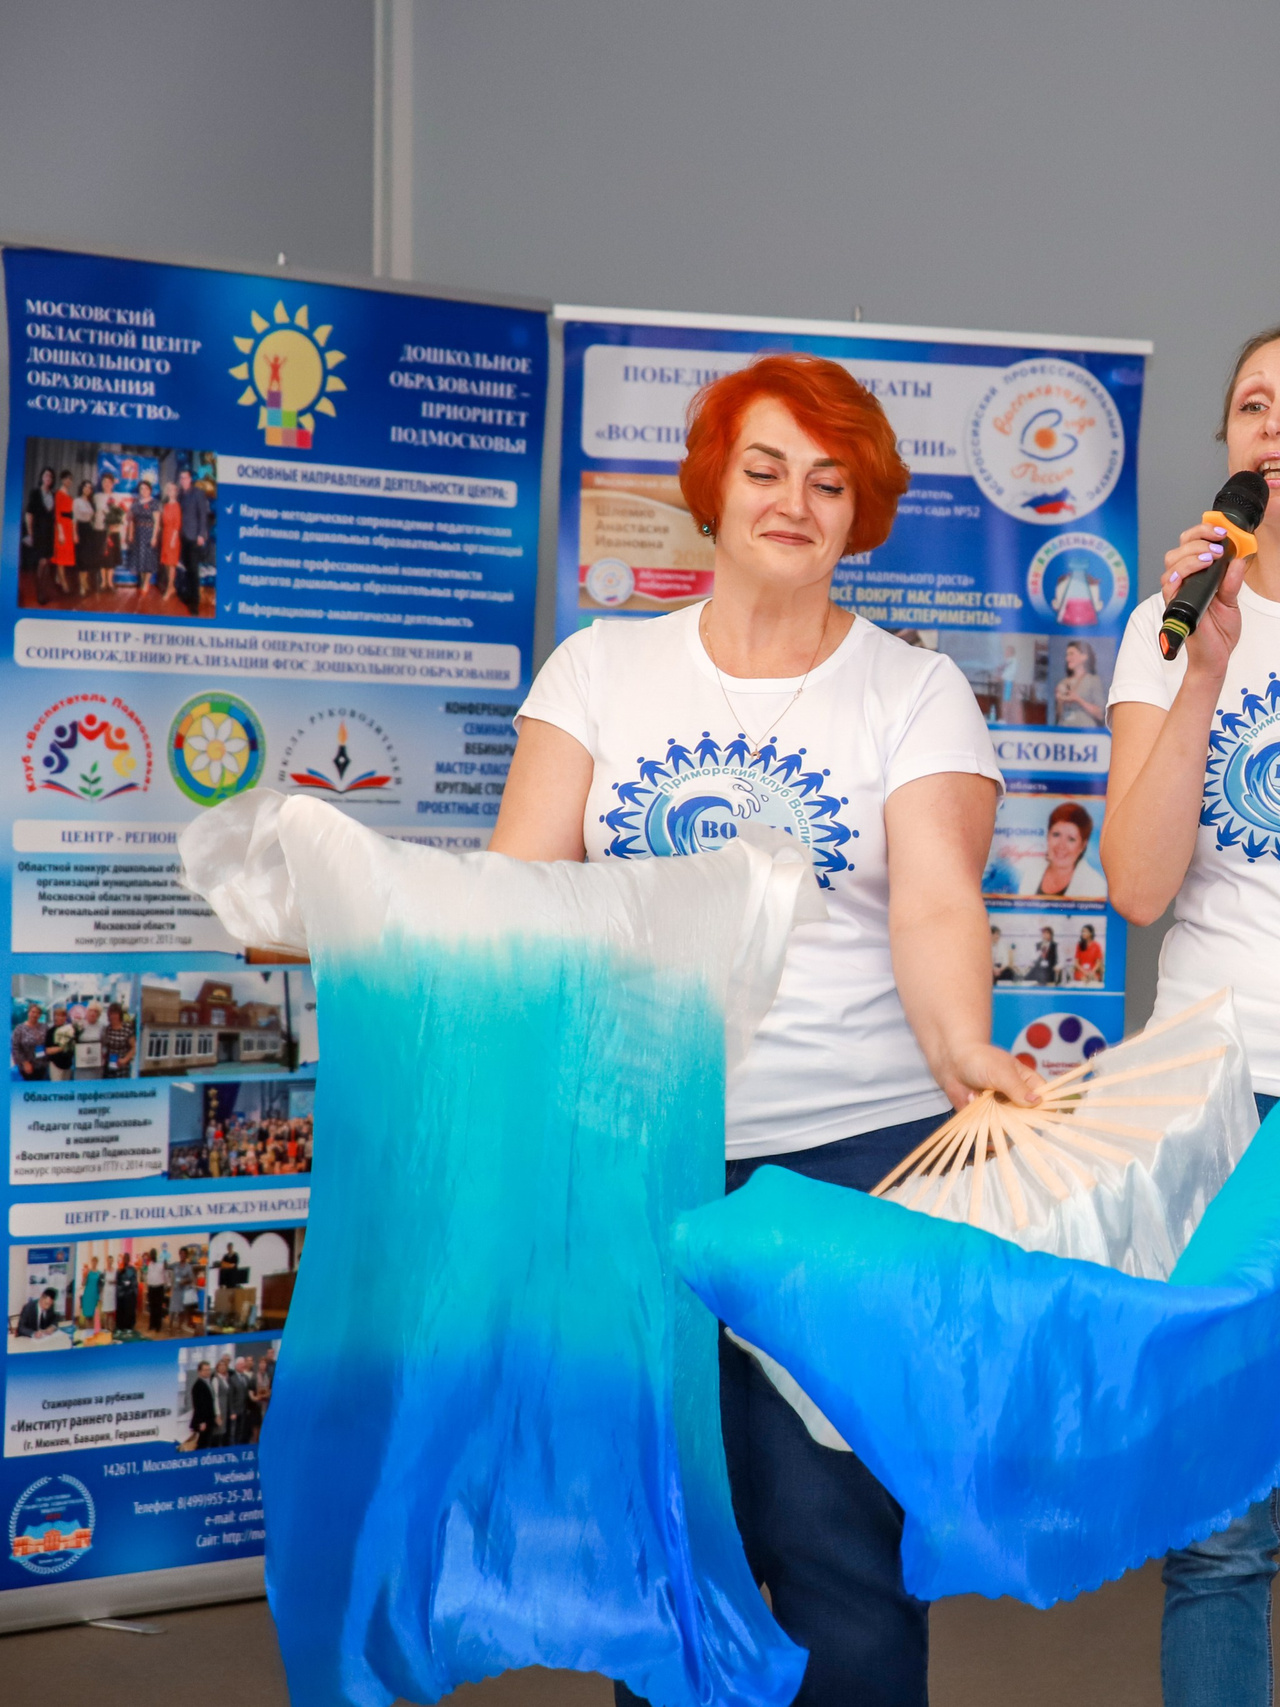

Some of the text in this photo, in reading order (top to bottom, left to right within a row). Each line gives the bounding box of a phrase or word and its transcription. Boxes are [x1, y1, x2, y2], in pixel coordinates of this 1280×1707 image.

[26, 299, 156, 328] МОСКОВСКИЙ
[26, 323, 202, 355] ОБЛАСТНОЙ ЦЕНТР
[26, 346, 171, 375] ДОШКОЛЬНОГО
[399, 344, 532, 374] ДОШКОЛЬНОЕ
[27, 370, 155, 397] ОБРАЗОВАНИЯ
[389, 371, 517, 400] ОБРАЗОВАНИЕ
[623, 365, 731, 386] ПОБЕДИ
[27, 394, 180, 421] «СОДРУЖЕСТВО»
[421, 401, 529, 428] ПРИОРИТЕТ
[390, 426, 527, 455] ПОДМОСКОВЬЯ
[237, 463, 509, 500] ОСНОВНЫЕ НАПРАВЛЕНИЯ ДЕЯТЕЛЬНОСТИ ЦЕНТРА:
[239, 524, 300, 541] работников
[302, 531, 370, 546] дошкольных
[866, 571, 975, 588] маленького роста»
[855, 587, 905, 603] ВОКРУГ
[907, 590, 933, 604] НАС
[935, 591, 982, 606] МОЖЕТ
[984, 593, 1023, 609] СТАТЬ
[77, 629, 473, 662] ЦЕНТР РЕГИОНАЛЬНЫЙ ОПЕРАТОР ПО ОБЕСПЕЧЕНИЮ И
[26, 646, 511, 682] СОПРОВОЖДЕНИЮ РЕАЛИЗАЦИИ ФГОС ДОШКОЛЬНОГО ОБРАЗОВАНИЯ
[417, 801, 480, 815] ПРОЕКТНЫЕ
[659, 767, 757, 795] Приморский
[760, 776, 792, 799] клуб
[787, 798, 812, 849] Воспи
[61, 830, 114, 843] ЦЕНТР
[18, 861, 71, 873] Областной
[74, 864, 110, 875] конкурс
[36, 876, 100, 889] организаций
[38, 891, 95, 901] Московской
[98, 892, 131, 901] области
[42, 905, 110, 916] Региональной
[93, 920, 175, 931] Московской области
[23, 1090, 75, 1102] Областной
[78, 1106, 111, 1117] конкурс
[73, 1121, 92, 1130] года
[14, 1166, 50, 1178] конкурс
[64, 1209, 109, 1225] ЦЕНТР
[120, 1203, 203, 1220] ПЛОЩАДКА
[41, 1391, 145, 1410] Стажировки за рубежом
[10, 1407, 172, 1433] «Институт раннего развития»
[103, 1460, 140, 1477] 142611,
[142, 1456, 199, 1473] Московская
[214, 1469, 255, 1485] Учебный
[133, 1499, 174, 1516] Телефон:
